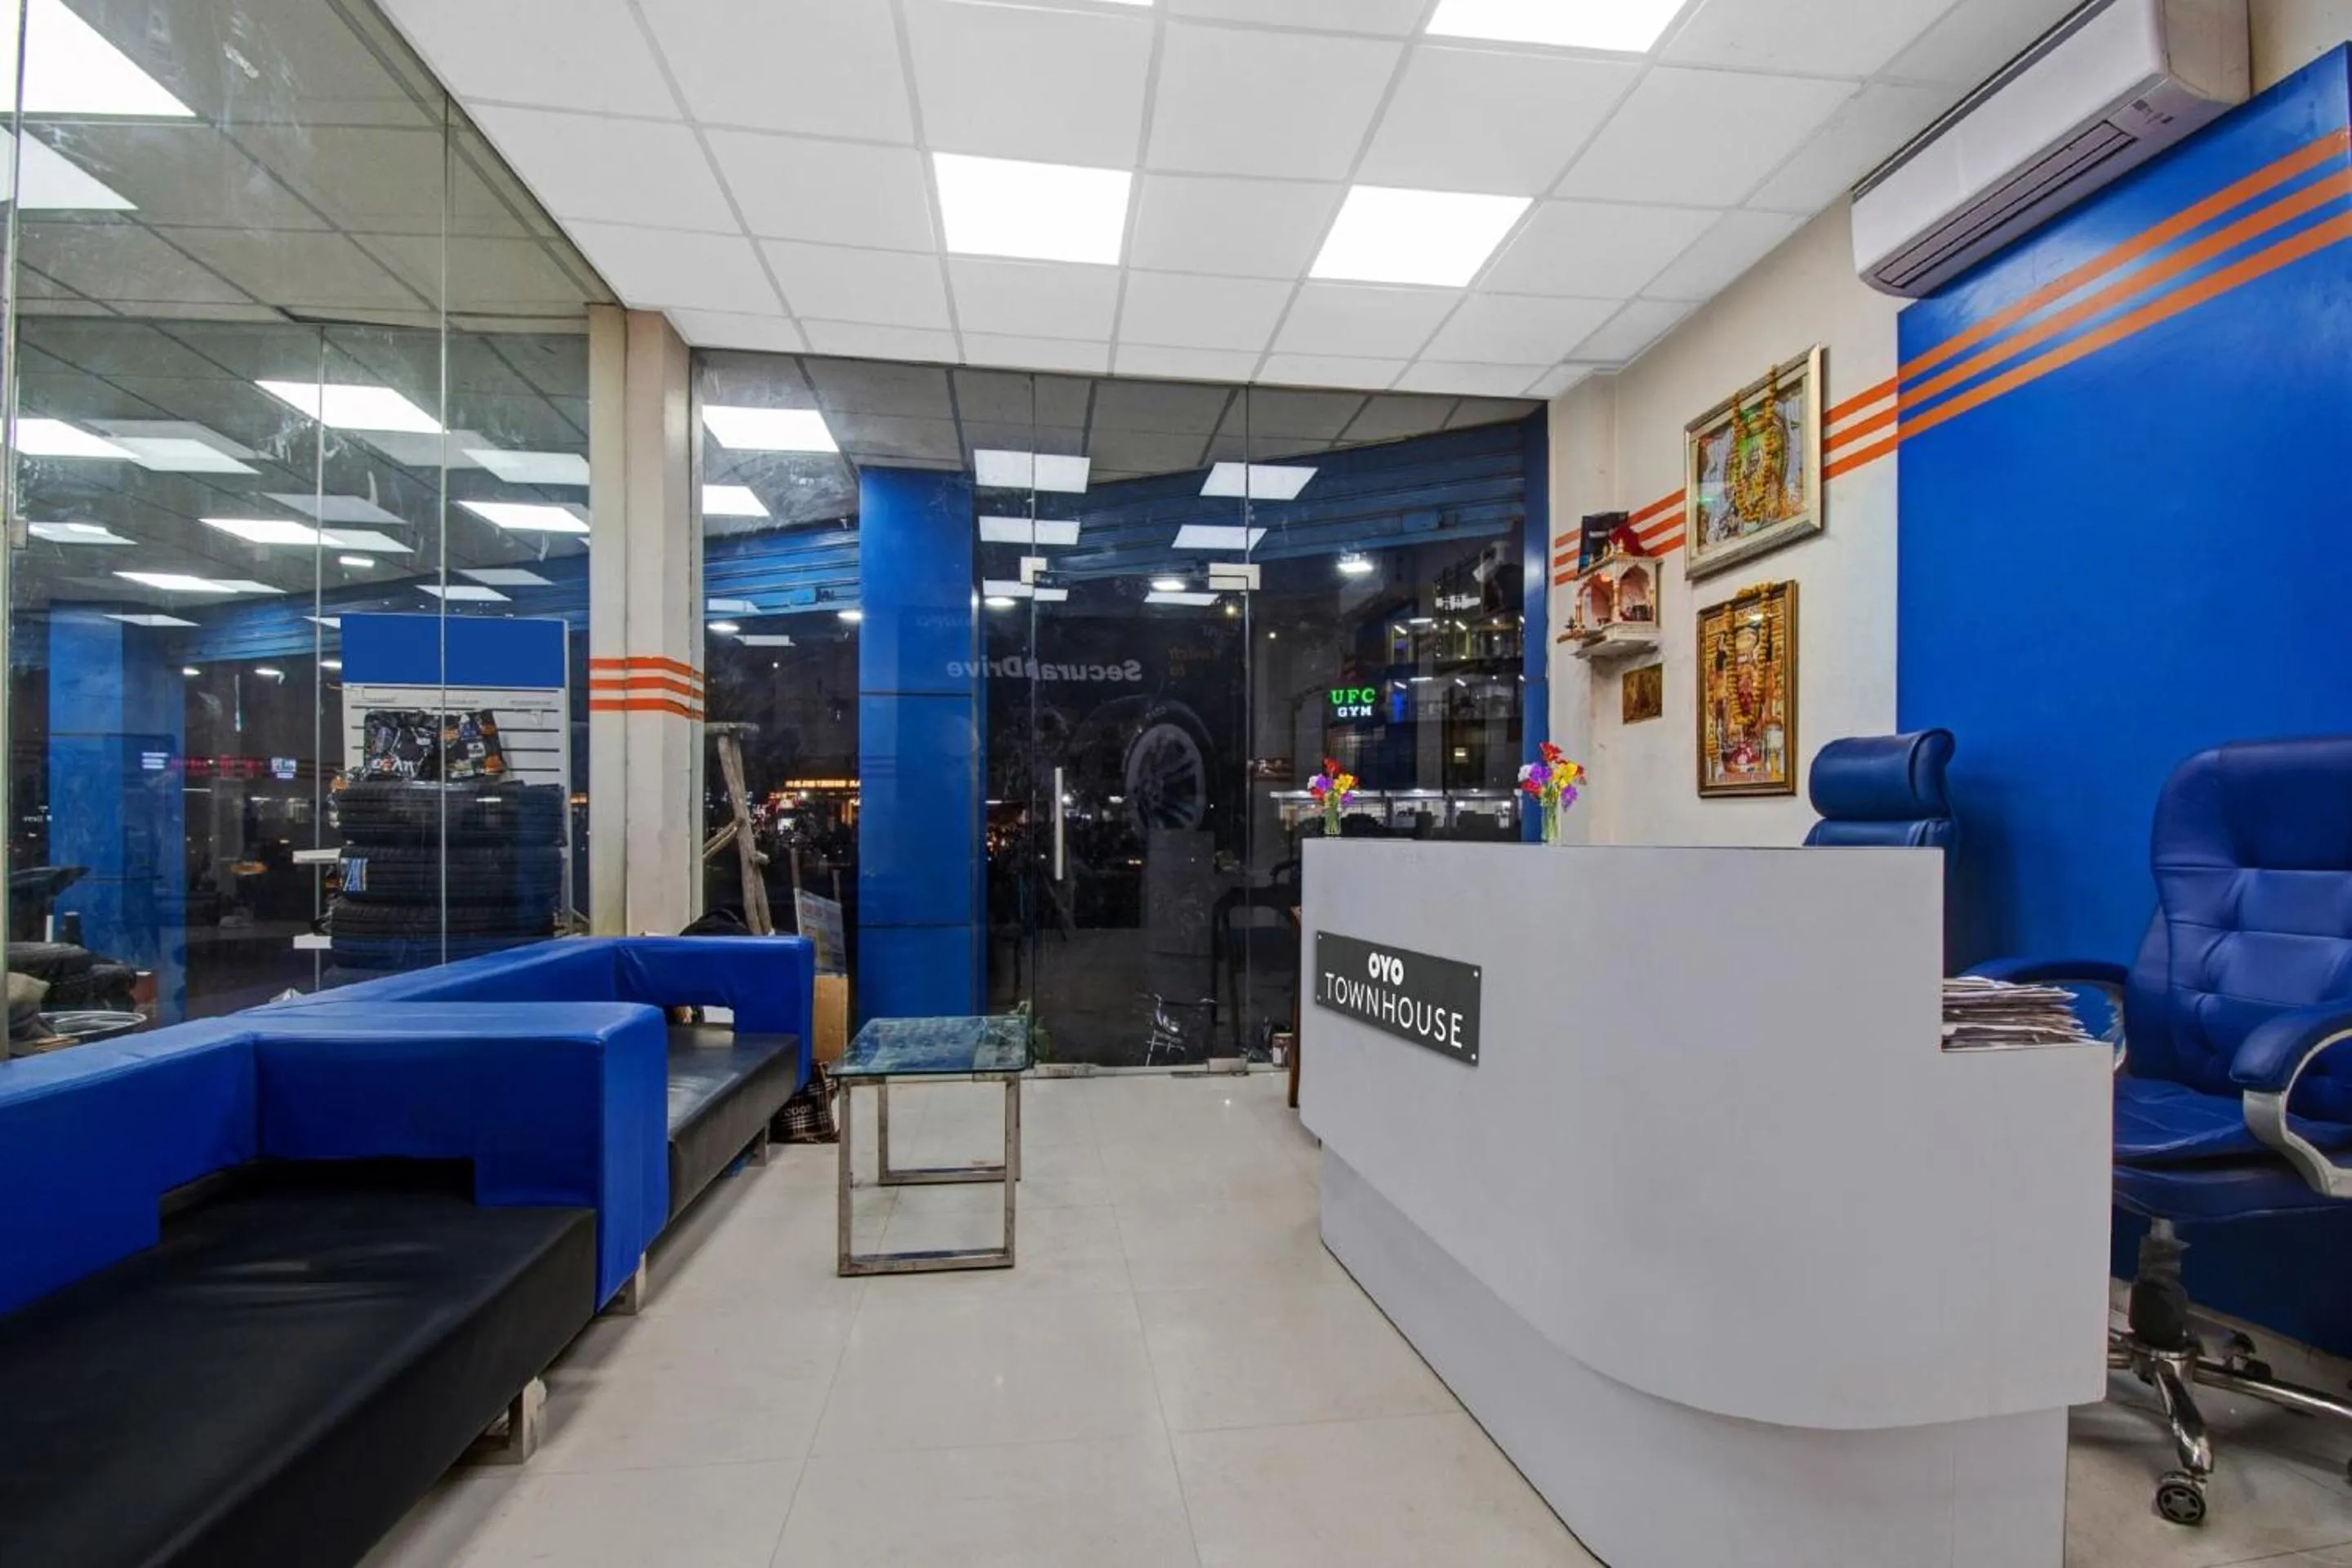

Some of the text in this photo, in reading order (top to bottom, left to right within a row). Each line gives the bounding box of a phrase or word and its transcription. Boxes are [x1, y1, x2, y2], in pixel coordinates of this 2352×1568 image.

[1330, 688, 1375, 704] UFC
[1338, 706, 1372, 717] GYM
[1368, 952, 1404, 986] OYO
[1325, 972, 1463, 1049] TOWNHOUSE
